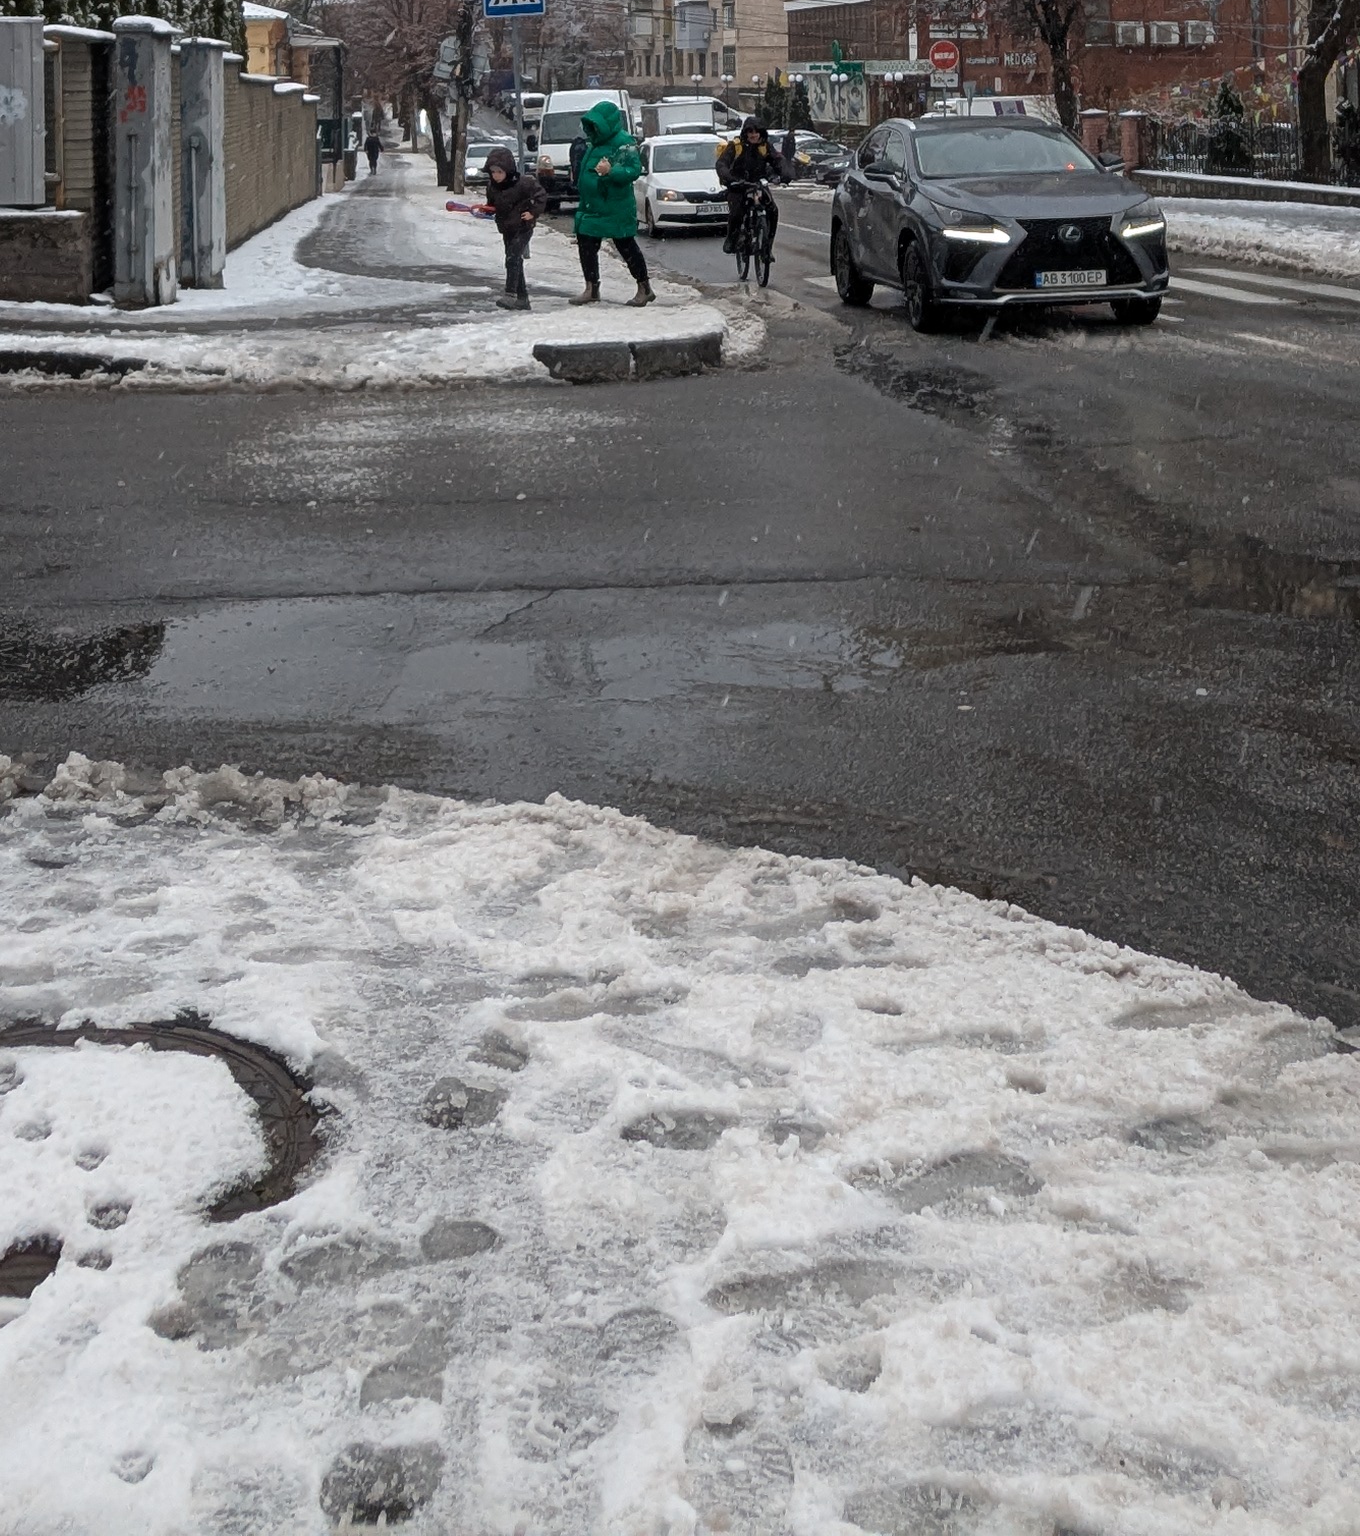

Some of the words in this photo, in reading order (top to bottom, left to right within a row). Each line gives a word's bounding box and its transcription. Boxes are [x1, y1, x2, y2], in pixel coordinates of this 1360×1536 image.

[1043, 273, 1059, 285] AB
[1060, 272, 1086, 284] 3100
[1087, 271, 1103, 283] EP
